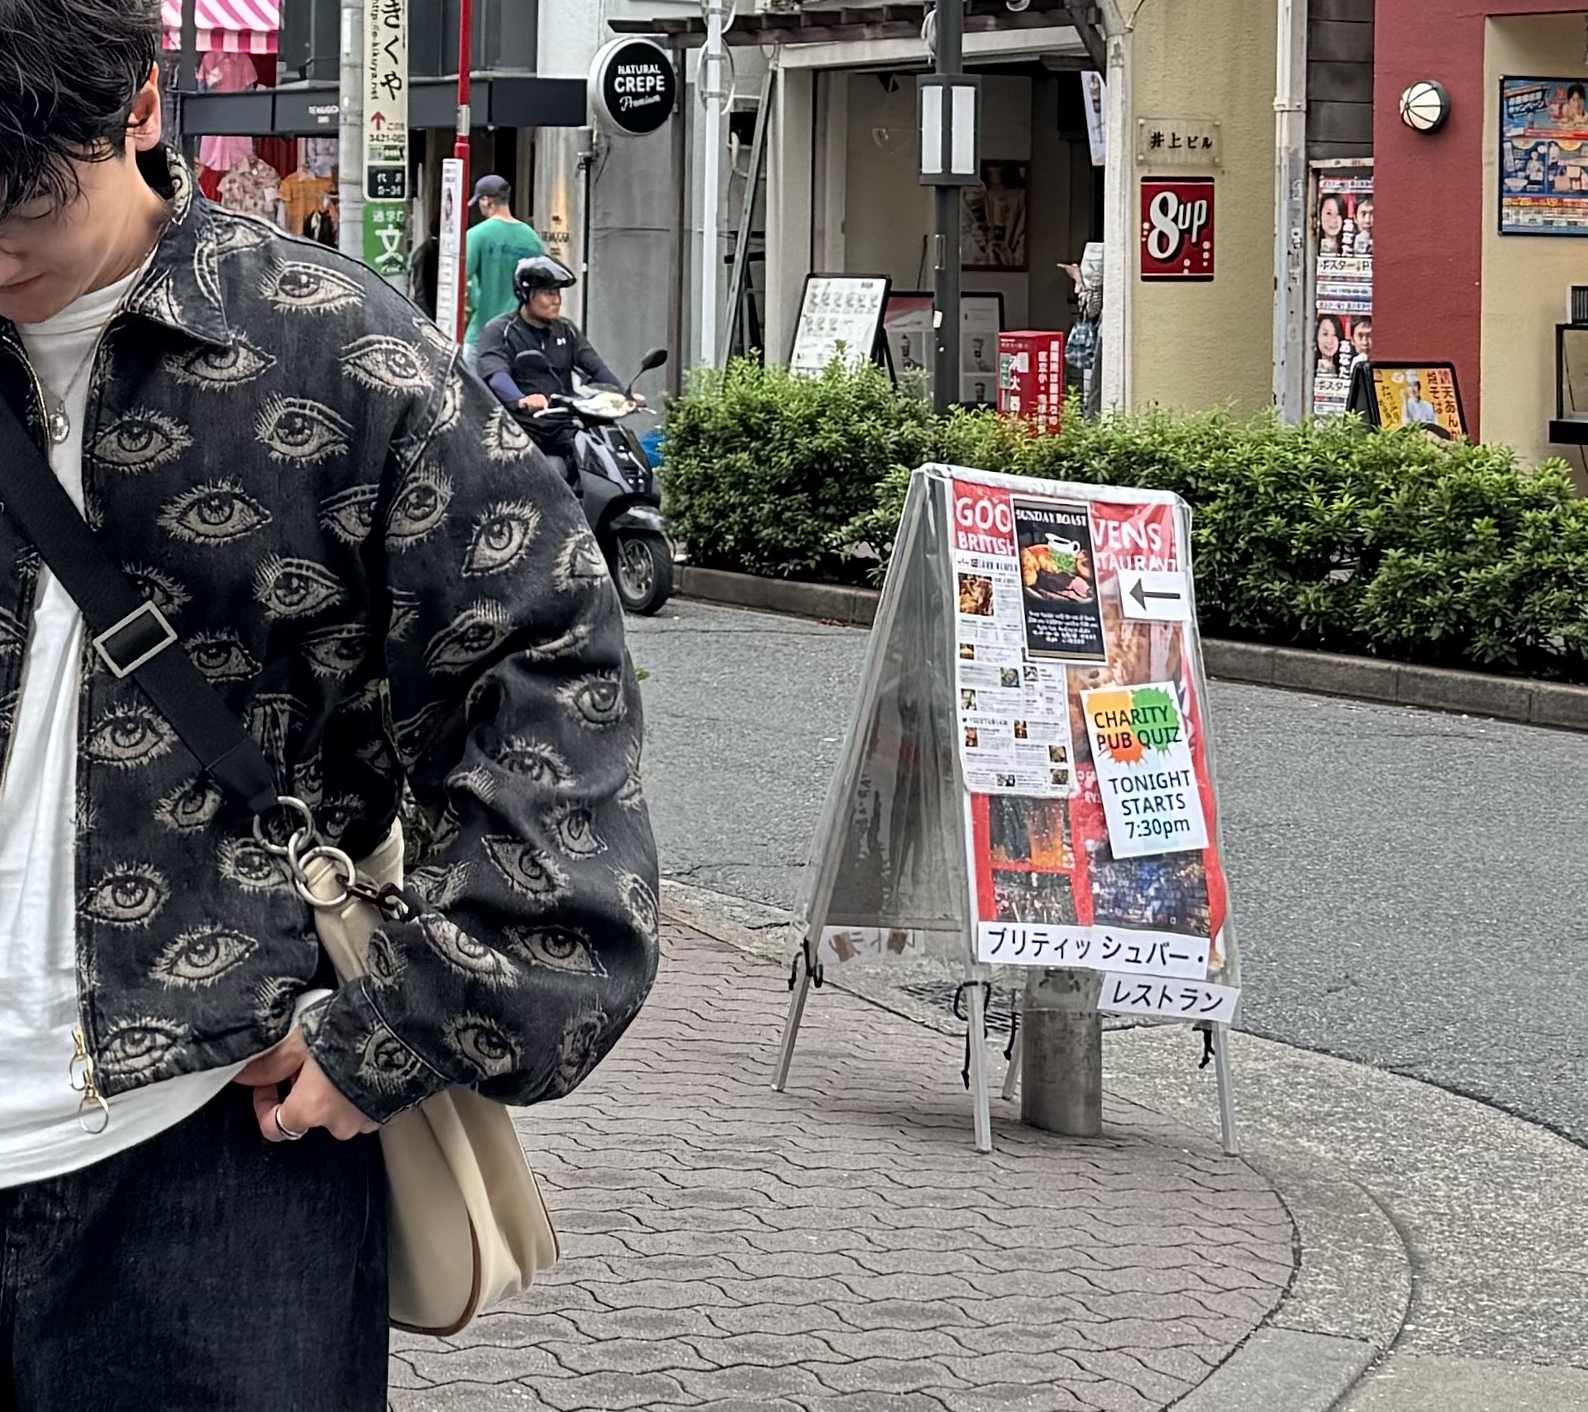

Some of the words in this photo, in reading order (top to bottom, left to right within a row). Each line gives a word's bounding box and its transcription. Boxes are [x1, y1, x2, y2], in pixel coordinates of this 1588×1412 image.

[618, 64, 661, 75] NATURAL
[614, 75, 666, 93] CREPE
[1150, 131, 1213, 150] 井上ビル
[1147, 191, 1207, 259] 8up
[956, 497, 1011, 534] GOO
[1092, 519, 1162, 552] VENS
[1016, 508, 1056, 524] SUNDAY
[1056, 513, 1087, 526] ROAST
[1096, 551, 1178, 572] TAURANT
[1093, 705, 1168, 729] CHARITY
[1096, 732, 1133, 752] PUB
[1137, 726, 1183, 750] QUIZ
[1108, 769, 1190, 795] TONIGHT
[1121, 793, 1186, 817] STARTS
[1125, 818, 1191, 840] 7:30pm
[1112, 980, 1224, 1013] レストラン
